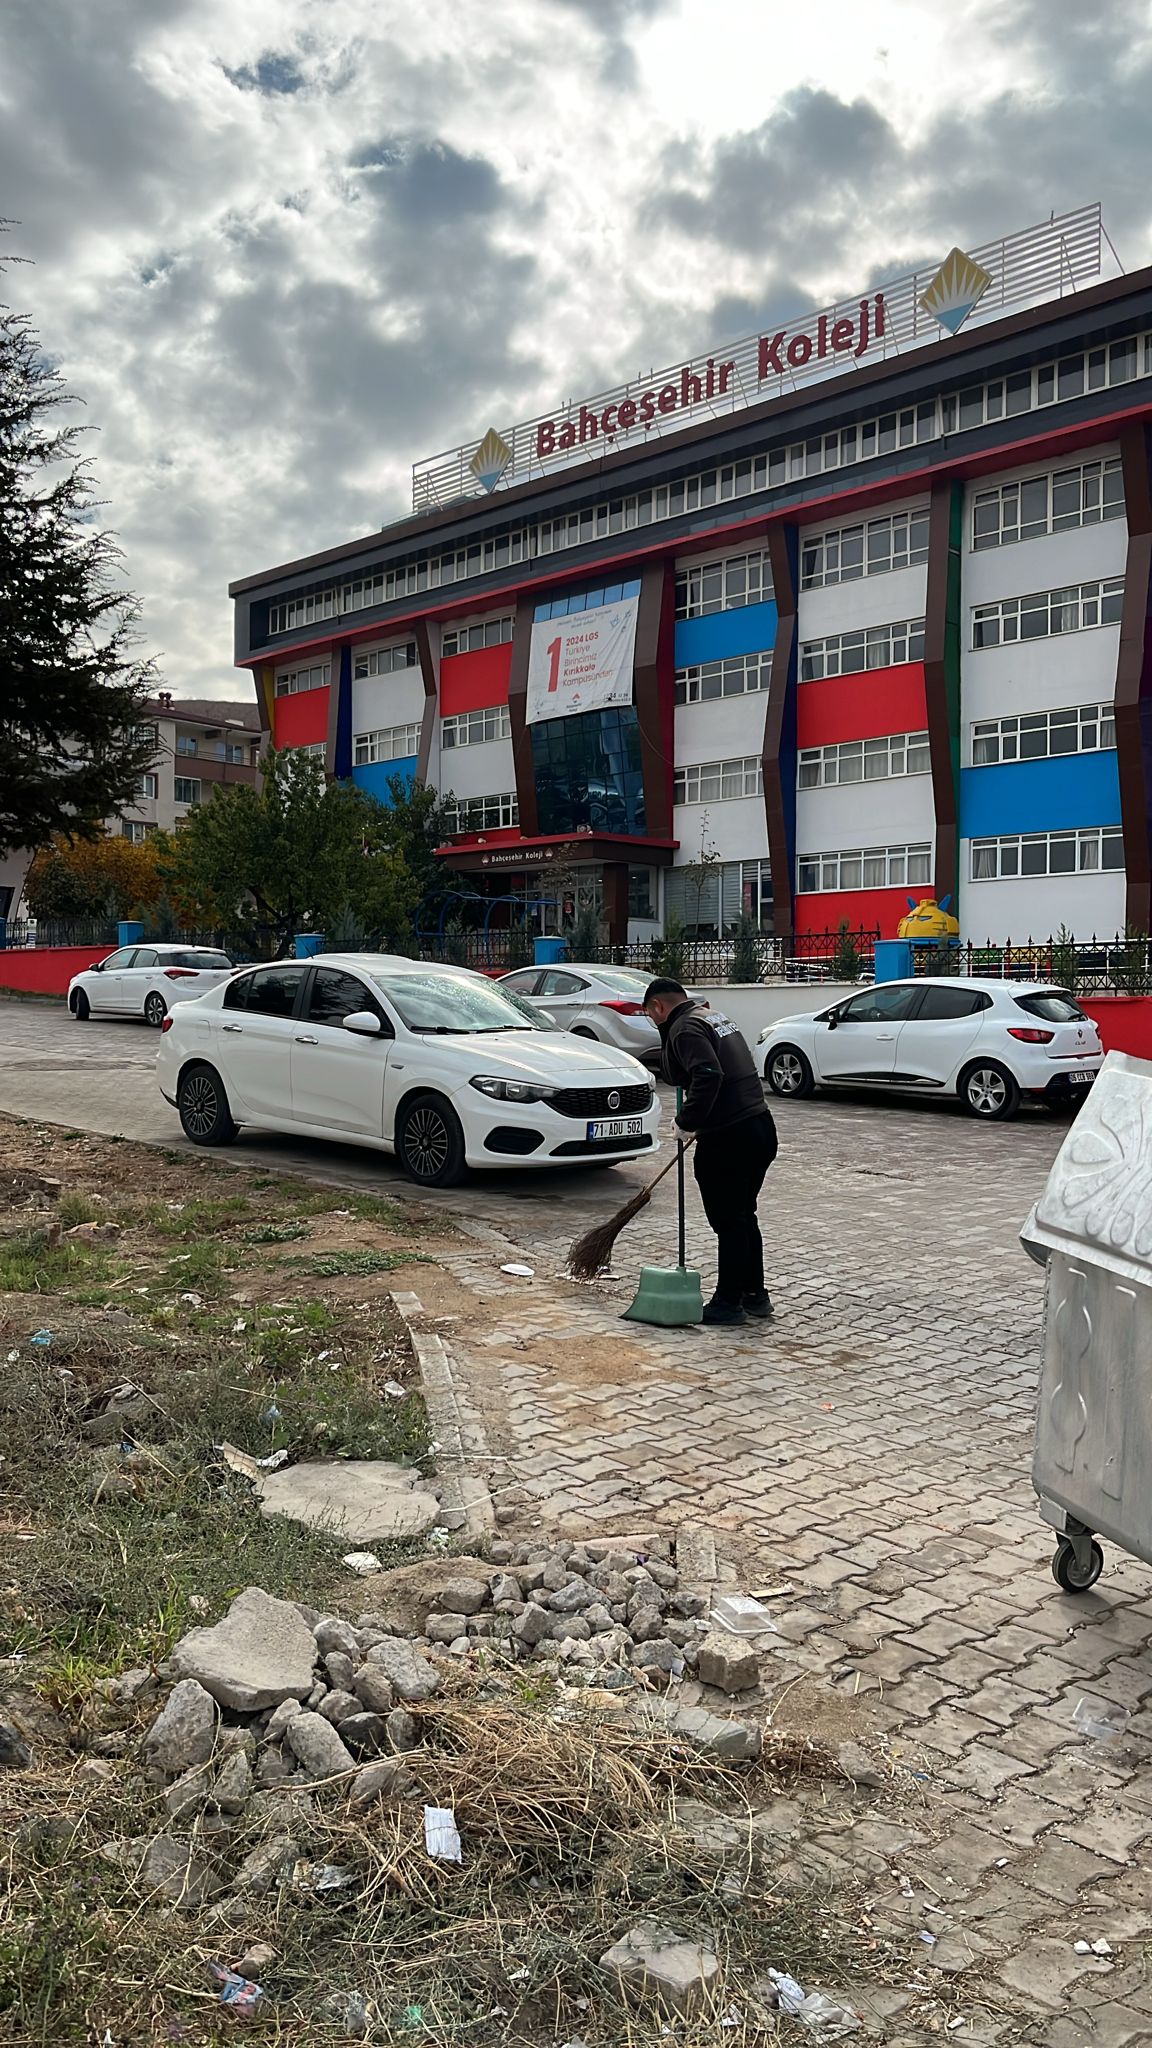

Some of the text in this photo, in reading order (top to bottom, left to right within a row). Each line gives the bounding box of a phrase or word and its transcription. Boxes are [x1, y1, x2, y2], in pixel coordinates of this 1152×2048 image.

[536, 293, 886, 458] Bahçeşehir Koleji
[566, 631, 599, 647] 2024 LGS
[546, 636, 562, 693] 1
[525, 850, 543, 860] Koleji
[594, 1120, 641, 1137] 71 ADU 502
